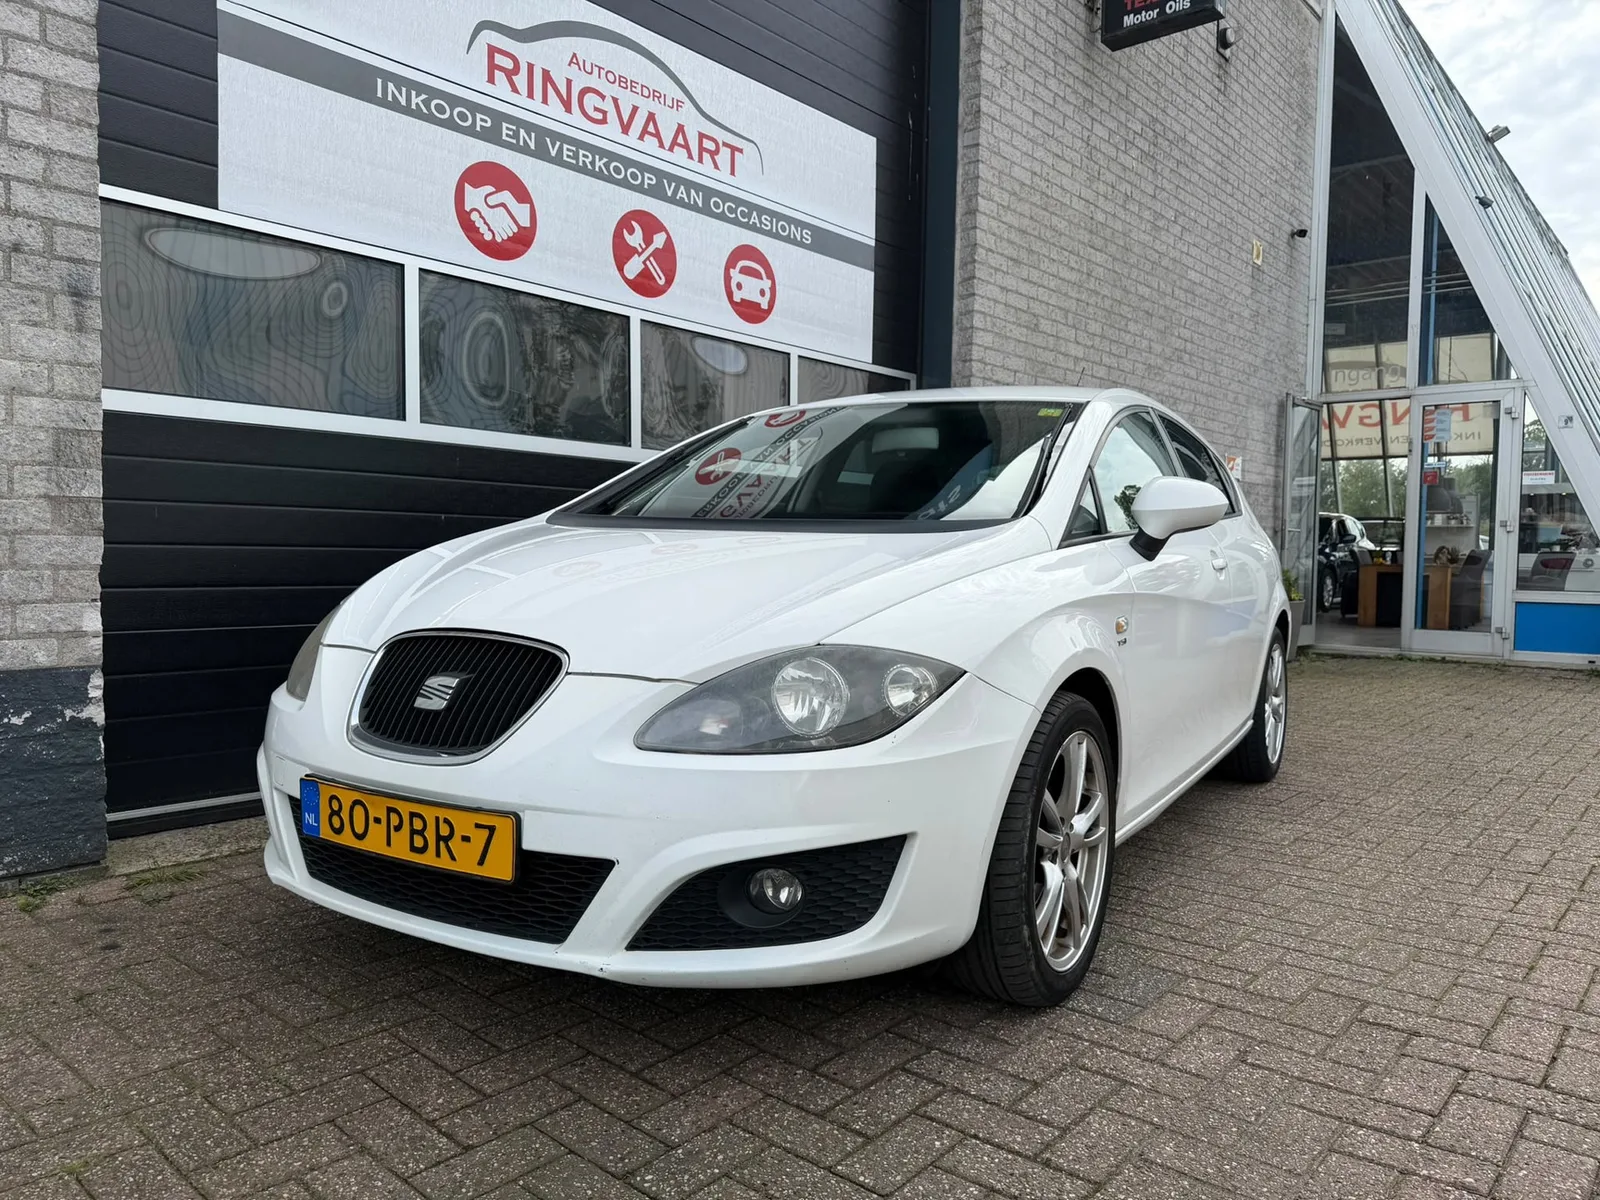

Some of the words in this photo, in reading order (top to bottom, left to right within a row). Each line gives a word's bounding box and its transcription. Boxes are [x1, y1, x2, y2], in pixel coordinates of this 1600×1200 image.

[1123, 8, 1159, 27] Motor
[1166, 0, 1190, 14] Oils
[486, 42, 743, 177] RINGVAART
[567, 52, 685, 112] AUTOBEDRIJF
[376, 77, 492, 132] INKOOP
[502, 121, 536, 150] EN
[545, 137, 656, 189] VERKOOP
[663, 178, 703, 208] VAN
[710, 197, 812, 244] OCCASIONS
[305, 812, 318, 826] NL
[328, 794, 496, 866] 80-PBR-7
